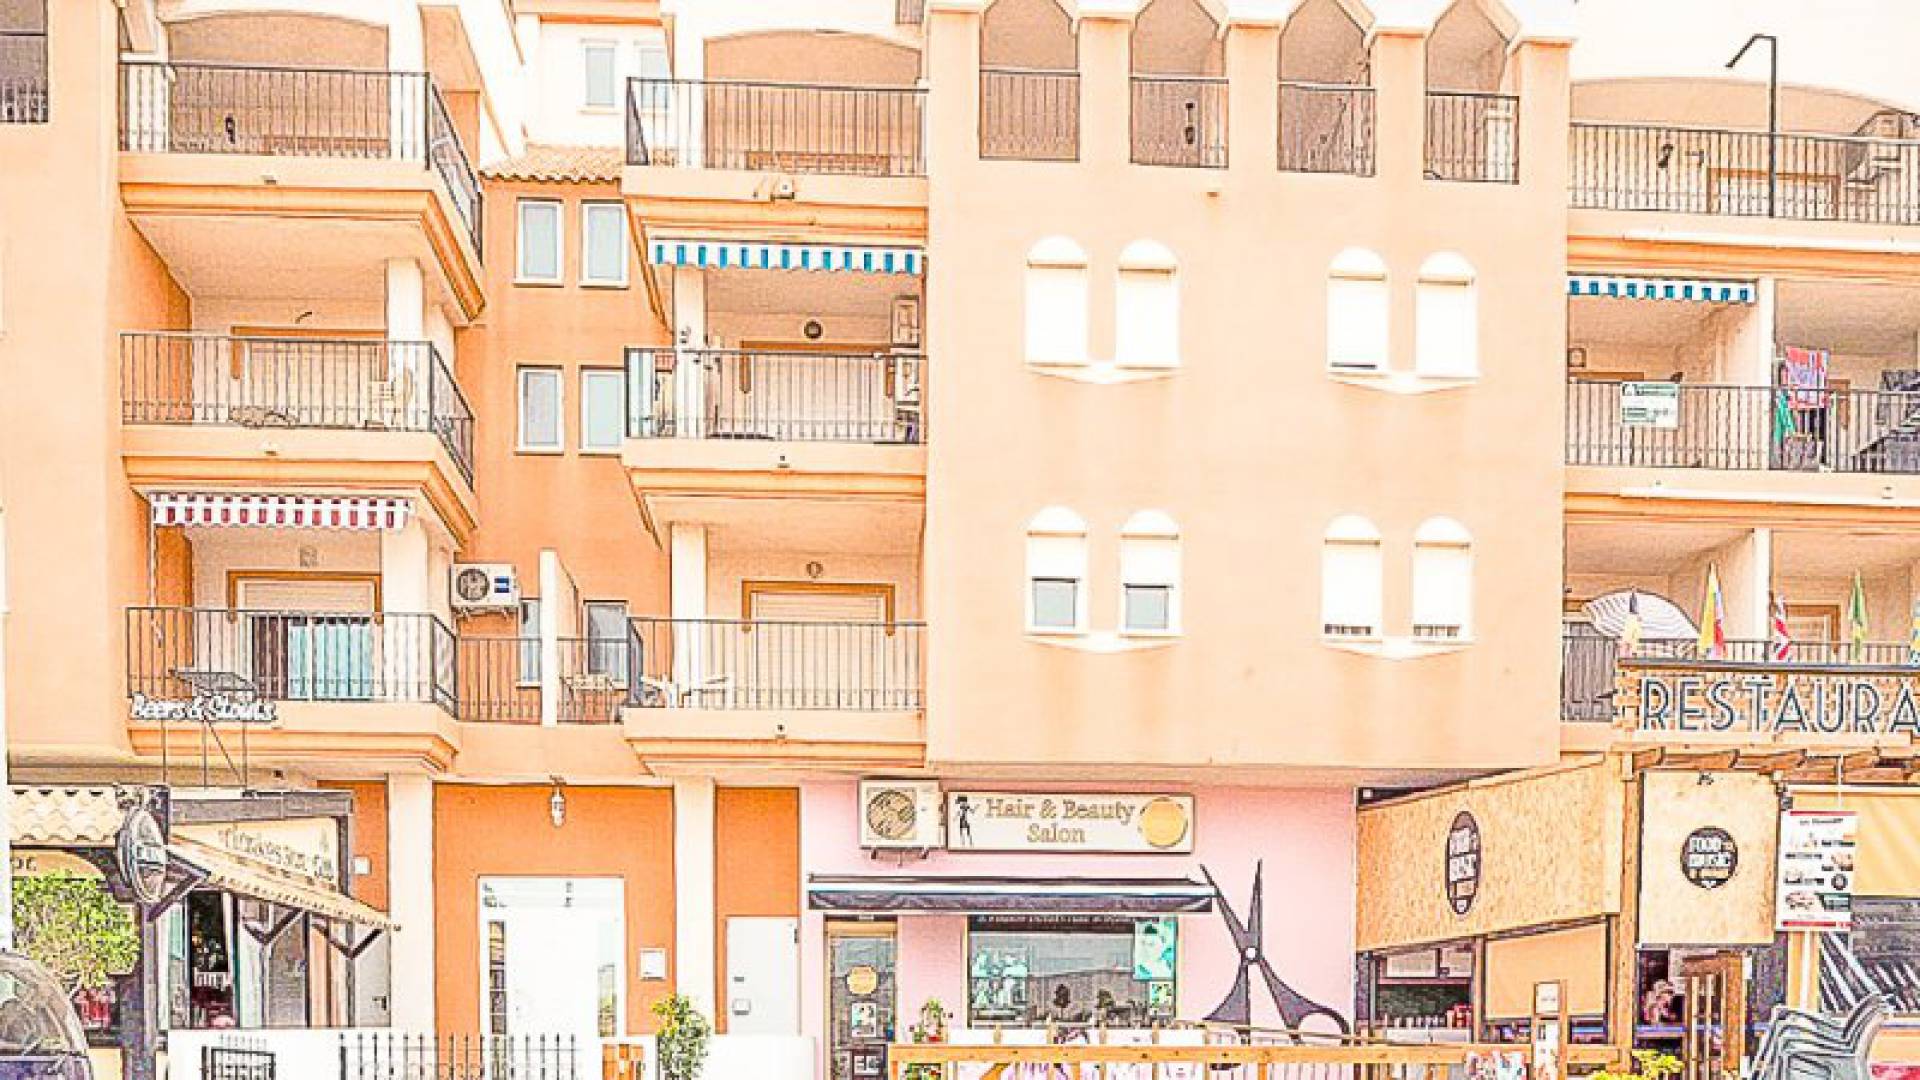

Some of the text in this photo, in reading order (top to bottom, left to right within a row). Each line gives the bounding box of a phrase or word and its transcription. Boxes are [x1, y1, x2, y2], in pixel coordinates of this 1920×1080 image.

[1640, 677, 1920, 733] RESTAURA
[985, 798, 1136, 826] Hair & Beauty
[1026, 822, 1086, 843] Salon
